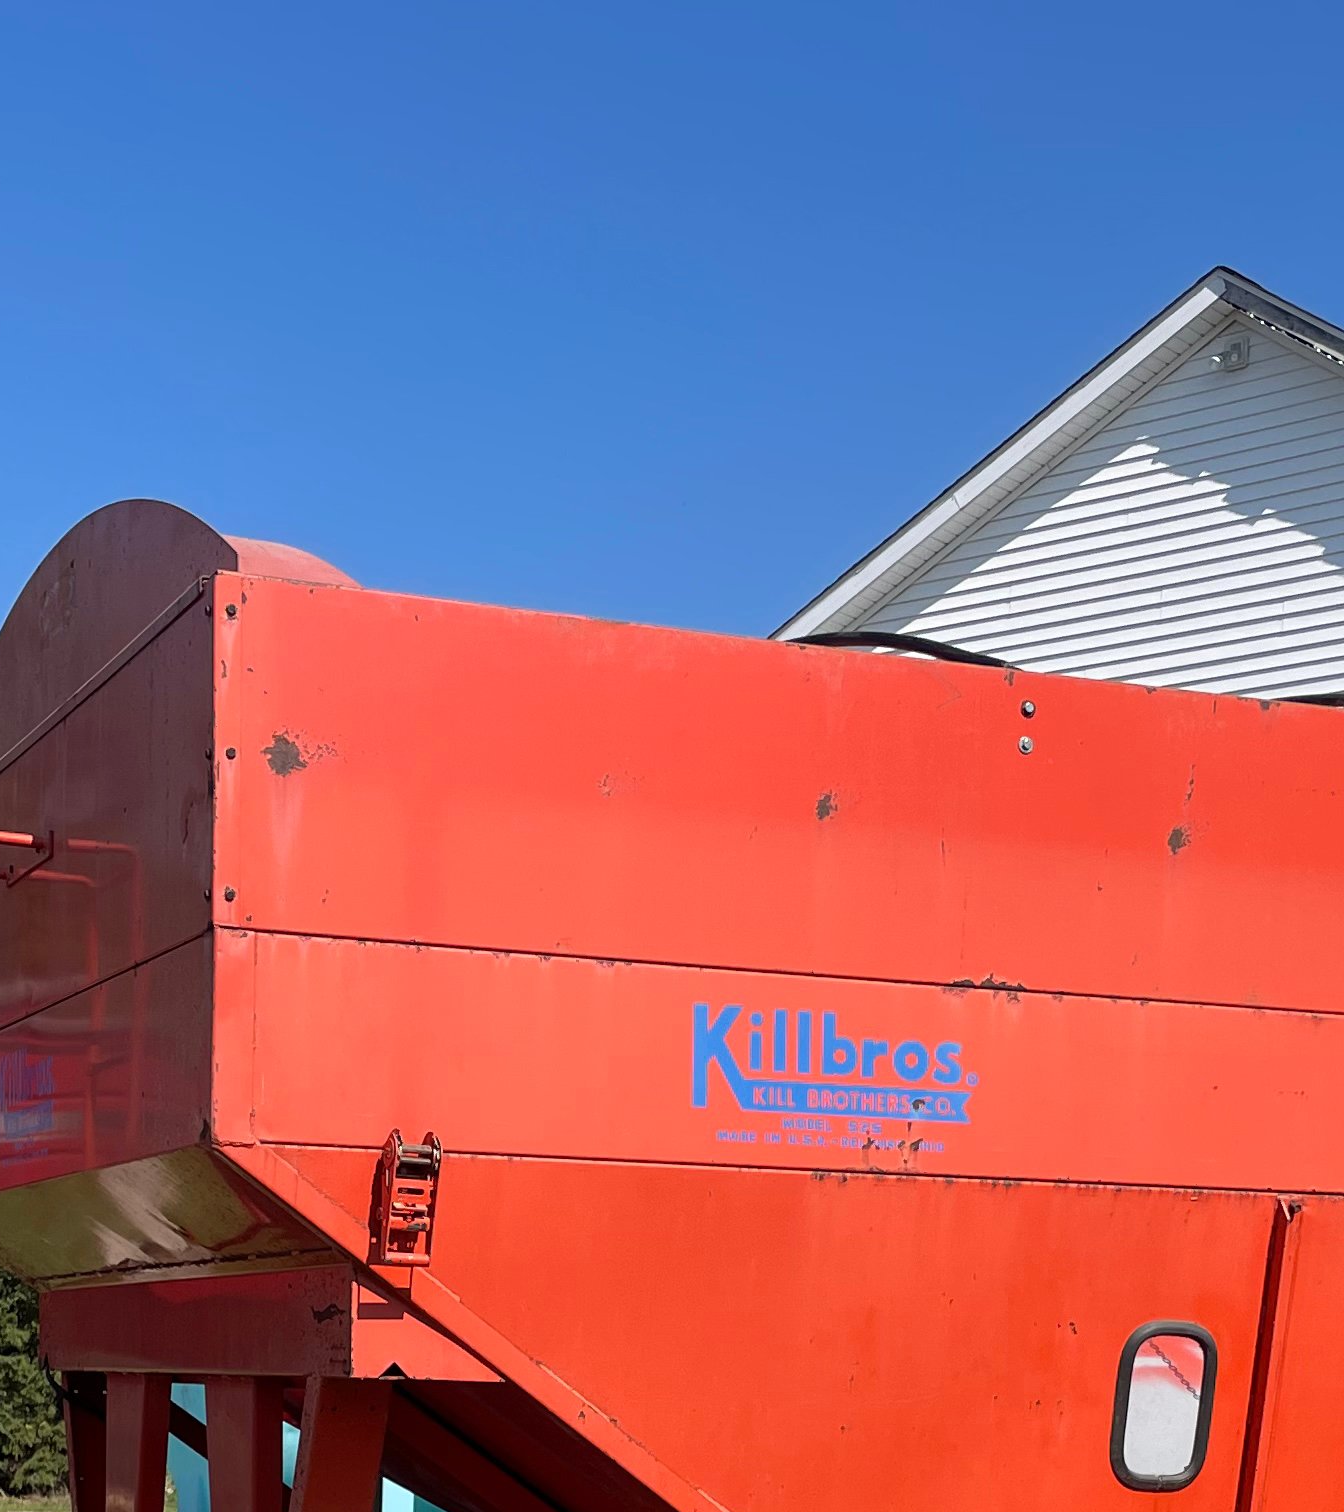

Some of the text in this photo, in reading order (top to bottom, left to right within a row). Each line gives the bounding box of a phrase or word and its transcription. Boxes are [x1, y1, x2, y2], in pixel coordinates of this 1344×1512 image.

[753, 1087, 796, 1108] KILL
[807, 1088, 911, 1115] BROTHERS
[781, 1118, 832, 1133] MODEL
